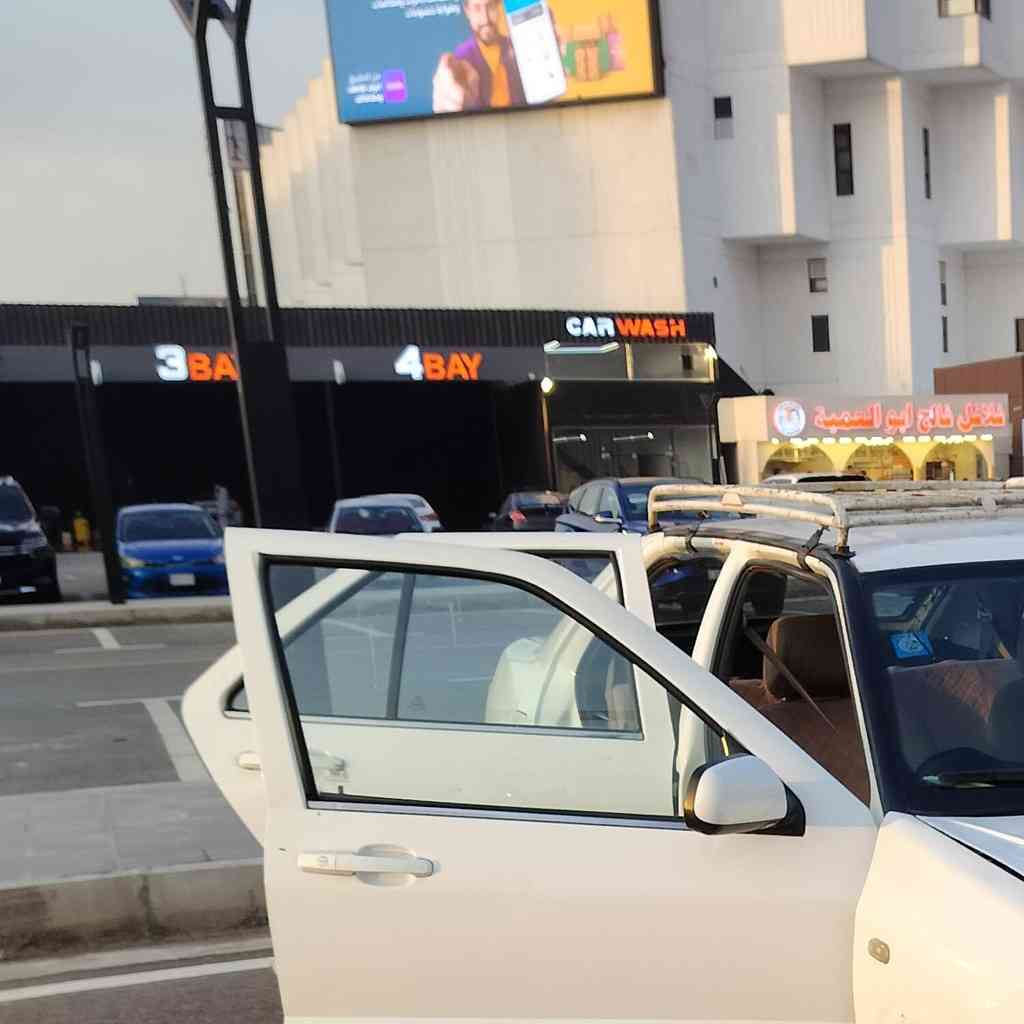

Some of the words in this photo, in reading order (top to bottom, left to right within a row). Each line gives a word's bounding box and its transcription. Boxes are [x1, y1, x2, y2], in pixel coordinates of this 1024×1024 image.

[565, 316, 615, 337] CAR
[615, 318, 686, 337] WASH
[154, 344, 240, 381] 3BA
